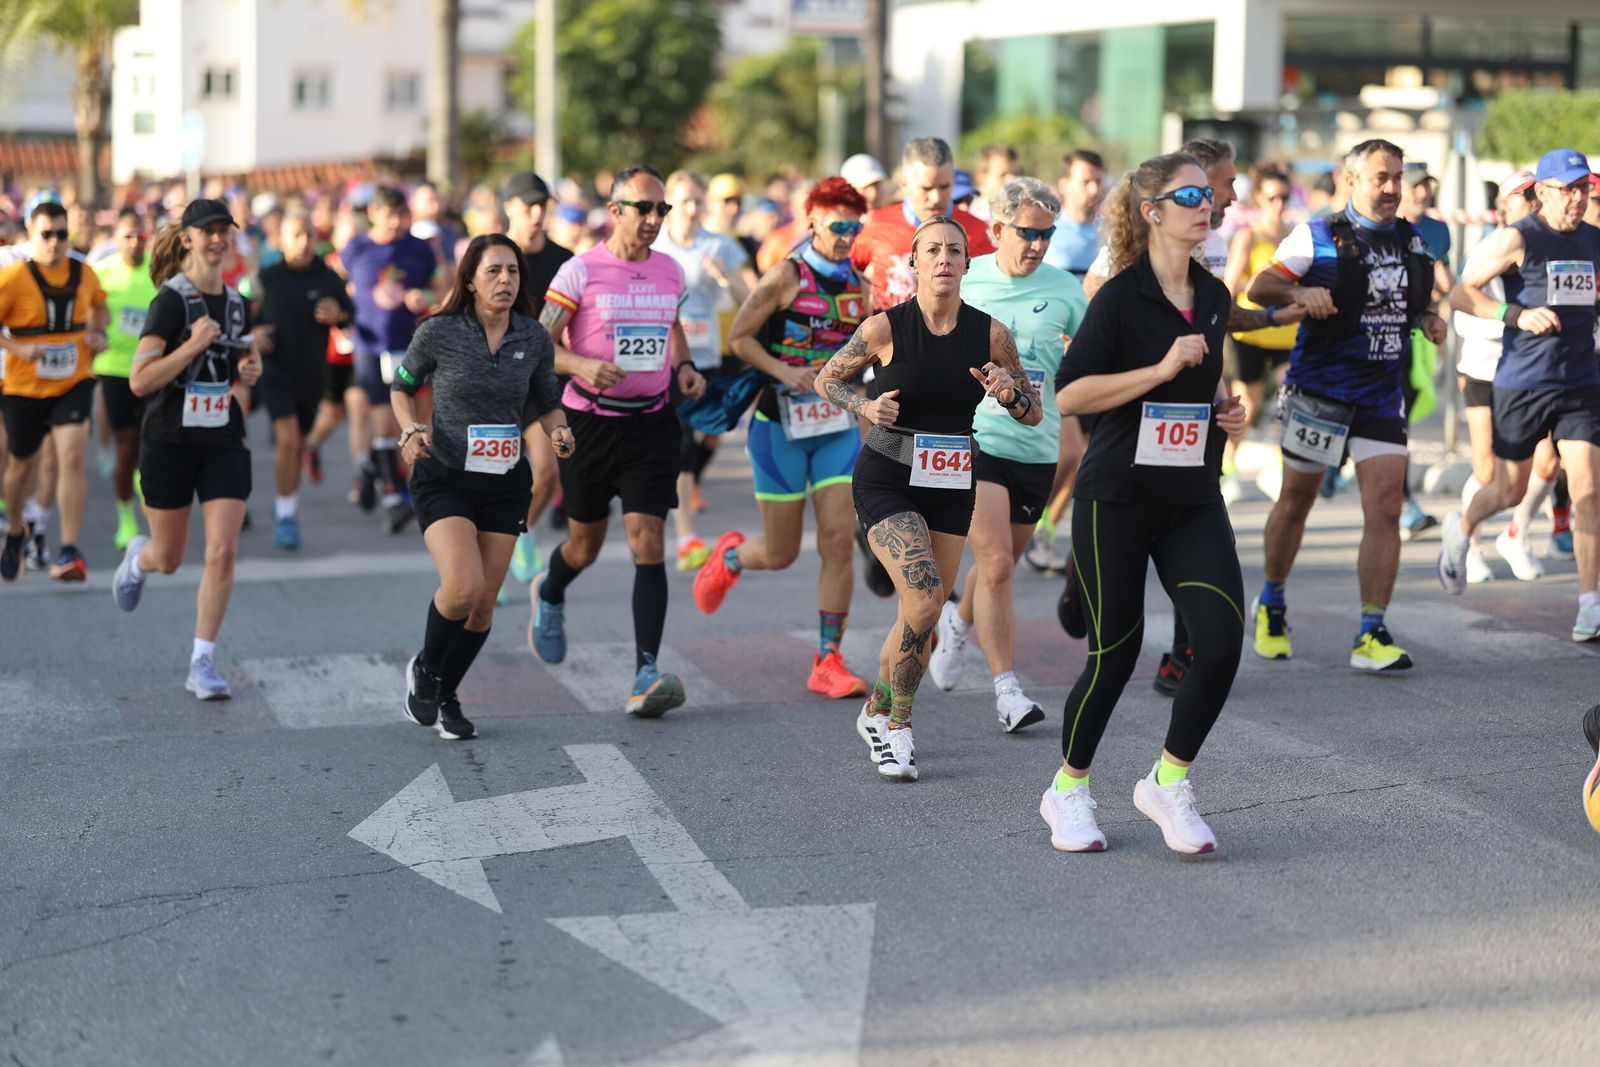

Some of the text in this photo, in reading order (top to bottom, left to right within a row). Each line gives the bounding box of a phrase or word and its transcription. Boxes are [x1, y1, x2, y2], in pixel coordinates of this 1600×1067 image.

[1553, 274, 1593, 290] 1425
[595, 294, 632, 309] MEDIA
[619, 338, 666, 356] 2237
[1156, 422, 1199, 446] 105
[1296, 428, 1332, 450] 431
[472, 439, 518, 458] 2368
[919, 450, 973, 472] 1642
